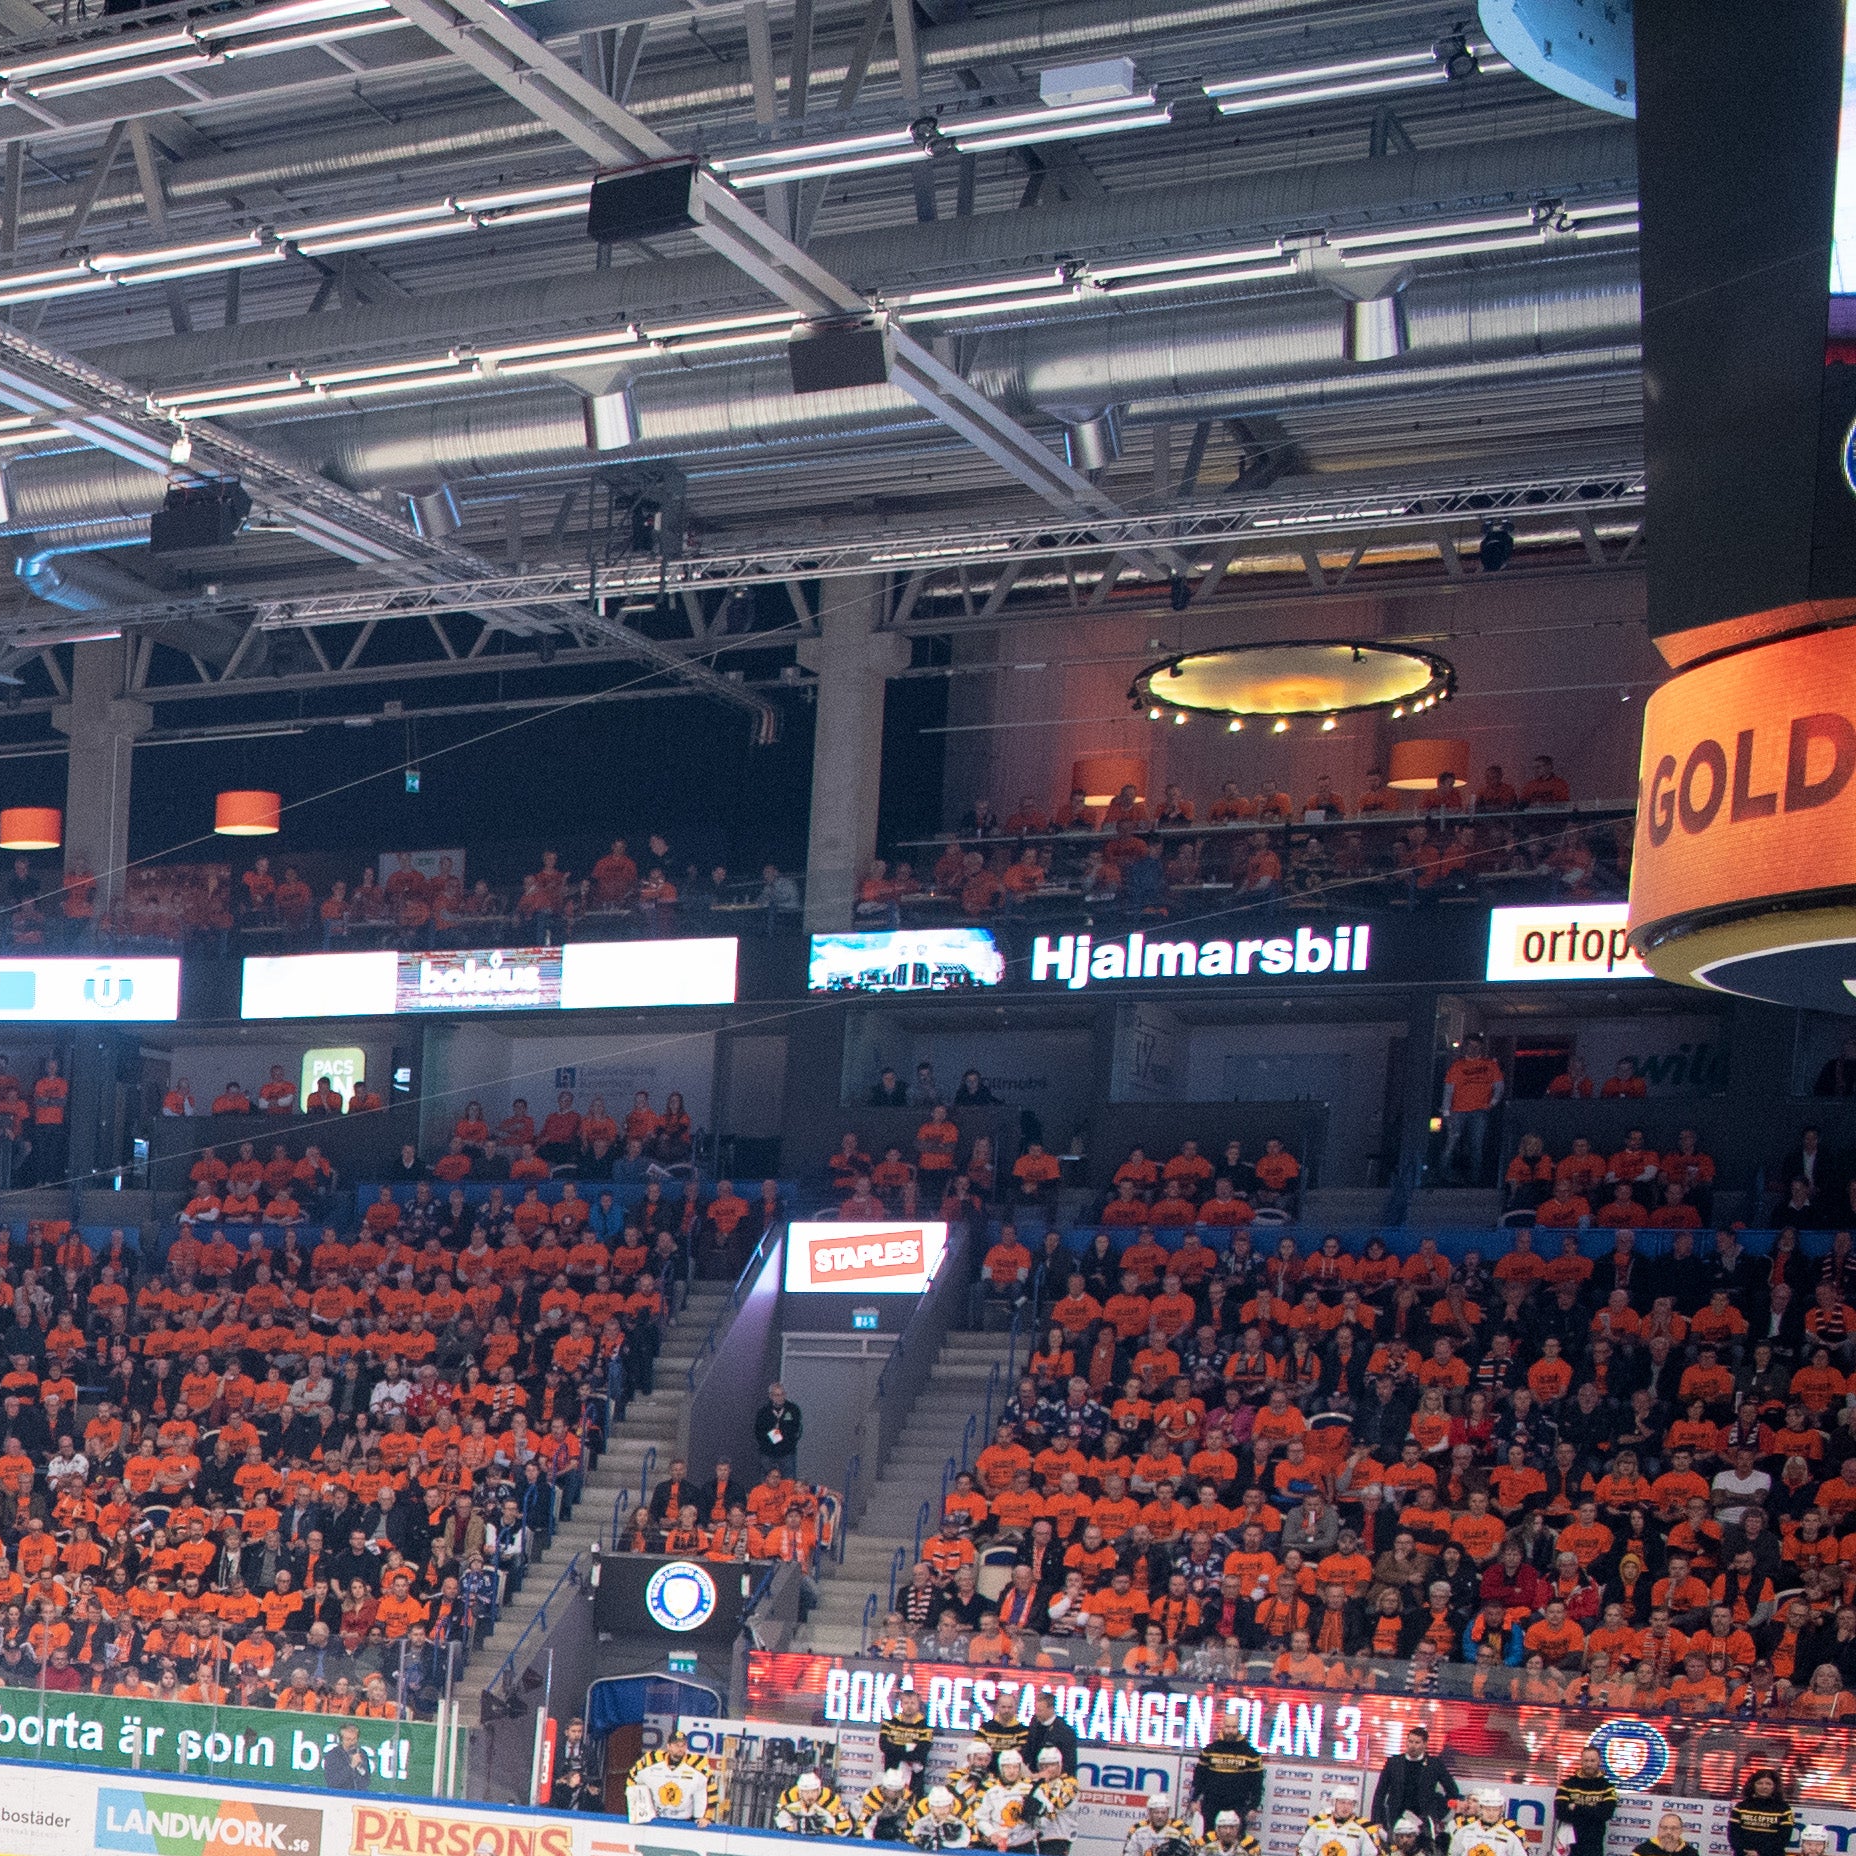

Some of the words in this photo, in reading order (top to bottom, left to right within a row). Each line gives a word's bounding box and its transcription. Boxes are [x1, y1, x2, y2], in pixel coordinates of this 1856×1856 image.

[1648, 711, 1856, 849] GOLD
[1030, 926, 1370, 989] Hjalmarsbil
[313, 1059, 354, 1077] PACS
[813, 1239, 921, 1275] STAPLES
[117, 1718, 165, 1757] är
[177, 1729, 274, 1768] som
[292, 1729, 411, 1781] bt!
[1331, 1705, 1362, 1762] 3
